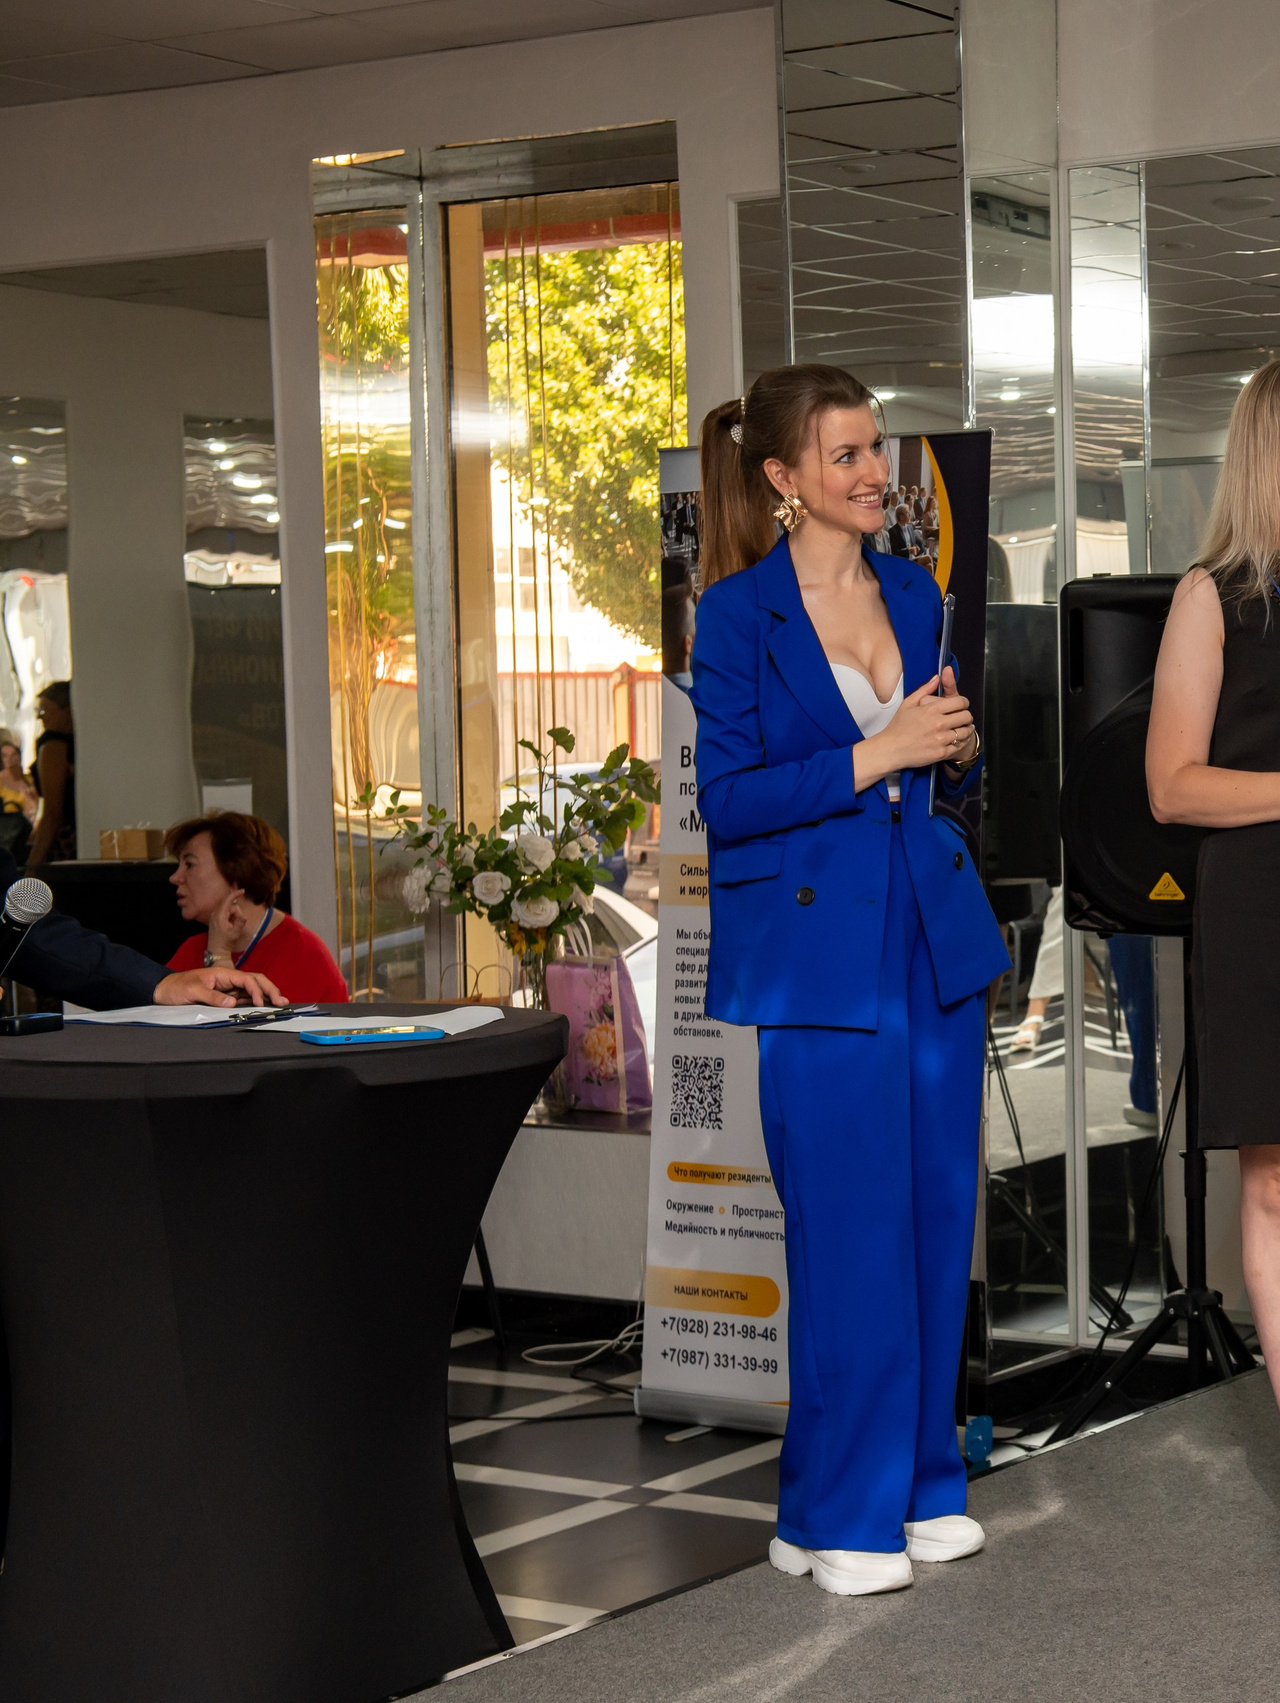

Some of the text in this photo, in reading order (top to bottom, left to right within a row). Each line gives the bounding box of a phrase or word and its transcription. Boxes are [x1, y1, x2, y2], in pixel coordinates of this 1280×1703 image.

[680, 885, 686, 895] и
[676, 928, 691, 940] Мы
[675, 960, 696, 974] сфер
[674, 995, 701, 1005] новых
[674, 1011, 679, 1020] в
[673, 1025, 723, 1039] обстановке.
[674, 1166, 771, 1184] Что получают резиденты
[666, 1199, 714, 1214] Окружение
[665, 1220, 718, 1236] Медийность
[728, 1226, 785, 1242] публичность
[674, 1285, 748, 1301] НАШИ КОНТАКТЫ
[661, 1316, 777, 1342] +7(928) 231-98-46
[661, 1348, 778, 1374] +7(987) 331-39-99
